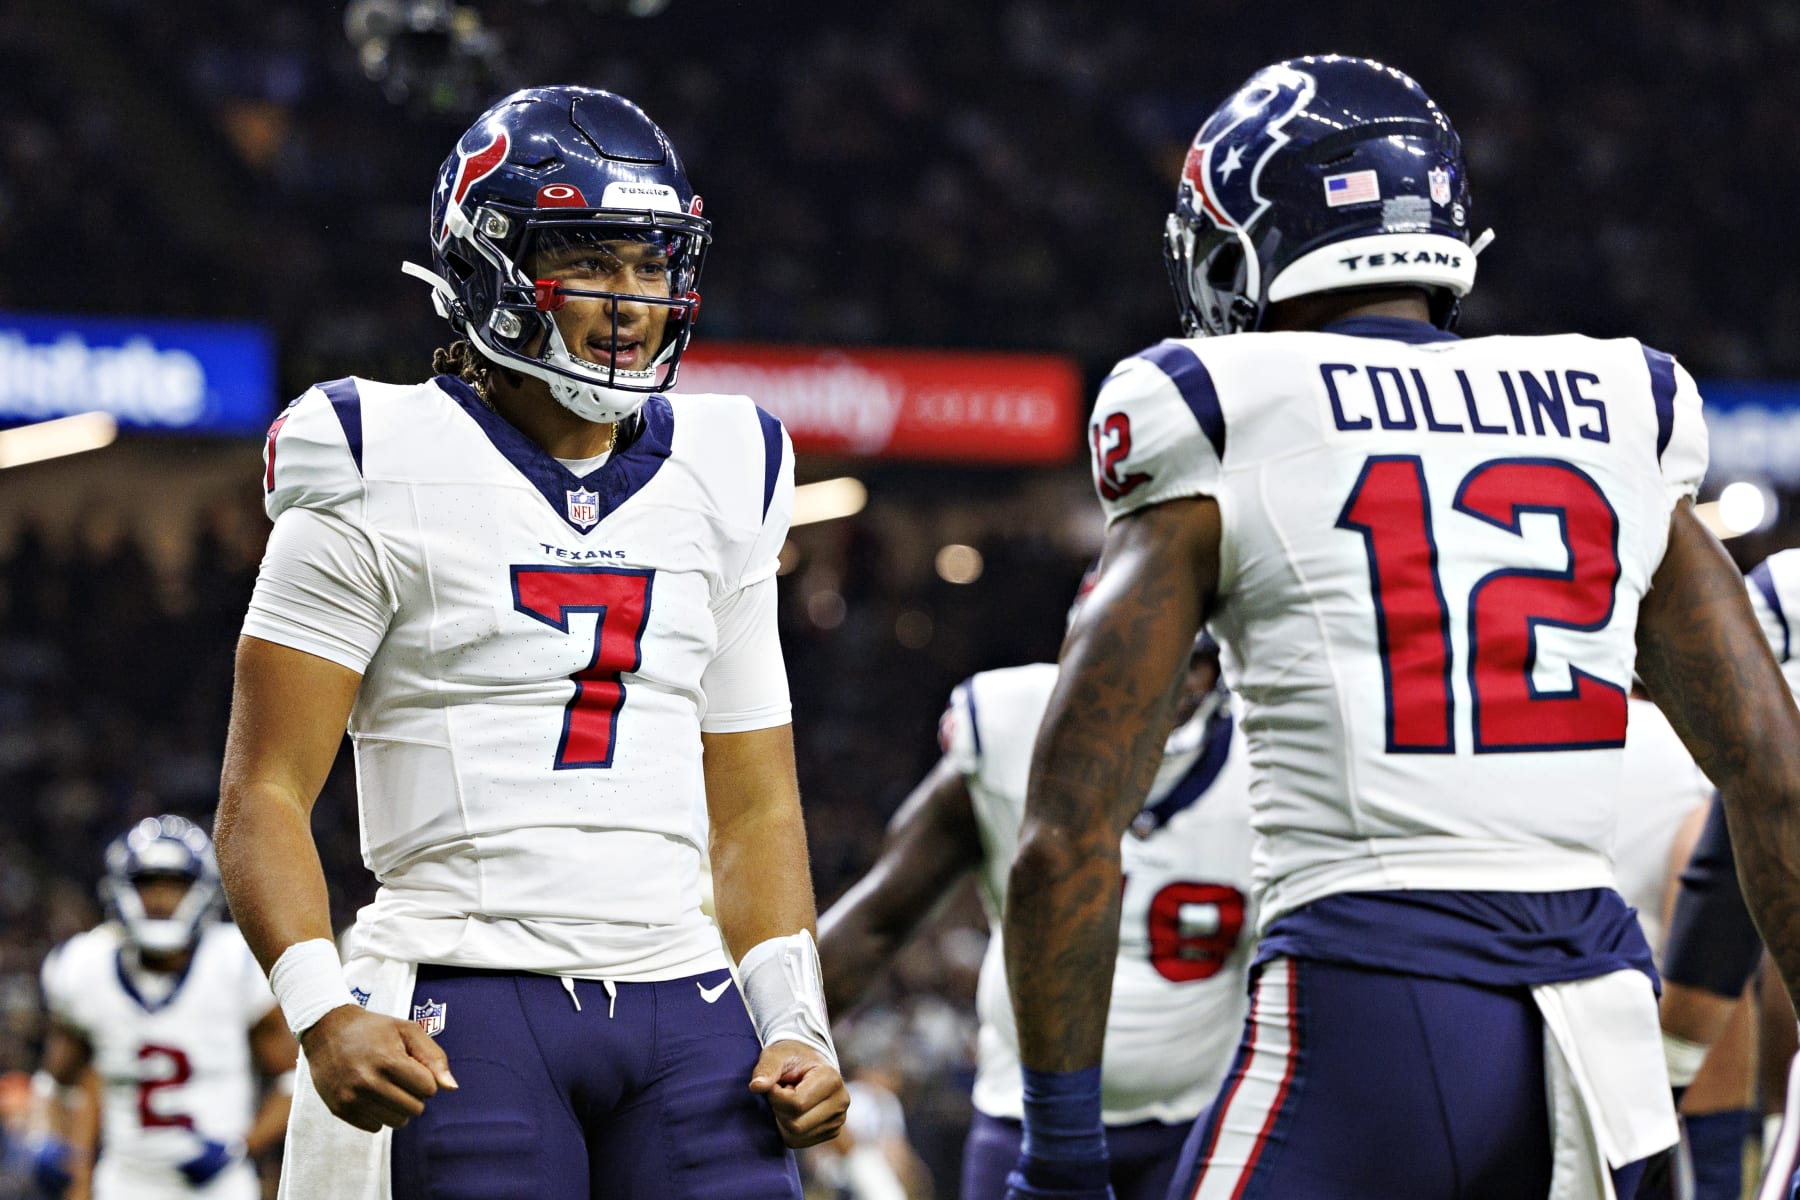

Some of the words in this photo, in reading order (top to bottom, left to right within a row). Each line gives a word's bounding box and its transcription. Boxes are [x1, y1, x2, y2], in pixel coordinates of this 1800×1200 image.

[1339, 251, 1461, 270] TEXANS
[1319, 363, 1610, 443] COLLINS
[1093, 412, 1154, 501] 12
[539, 543, 626, 560] TEXANS
[573, 505, 594, 520] NFL
[1334, 455, 1628, 754] 12
[509, 564, 656, 770] 7
[1120, 872, 1247, 983] 8
[138, 1044, 194, 1132] 2
